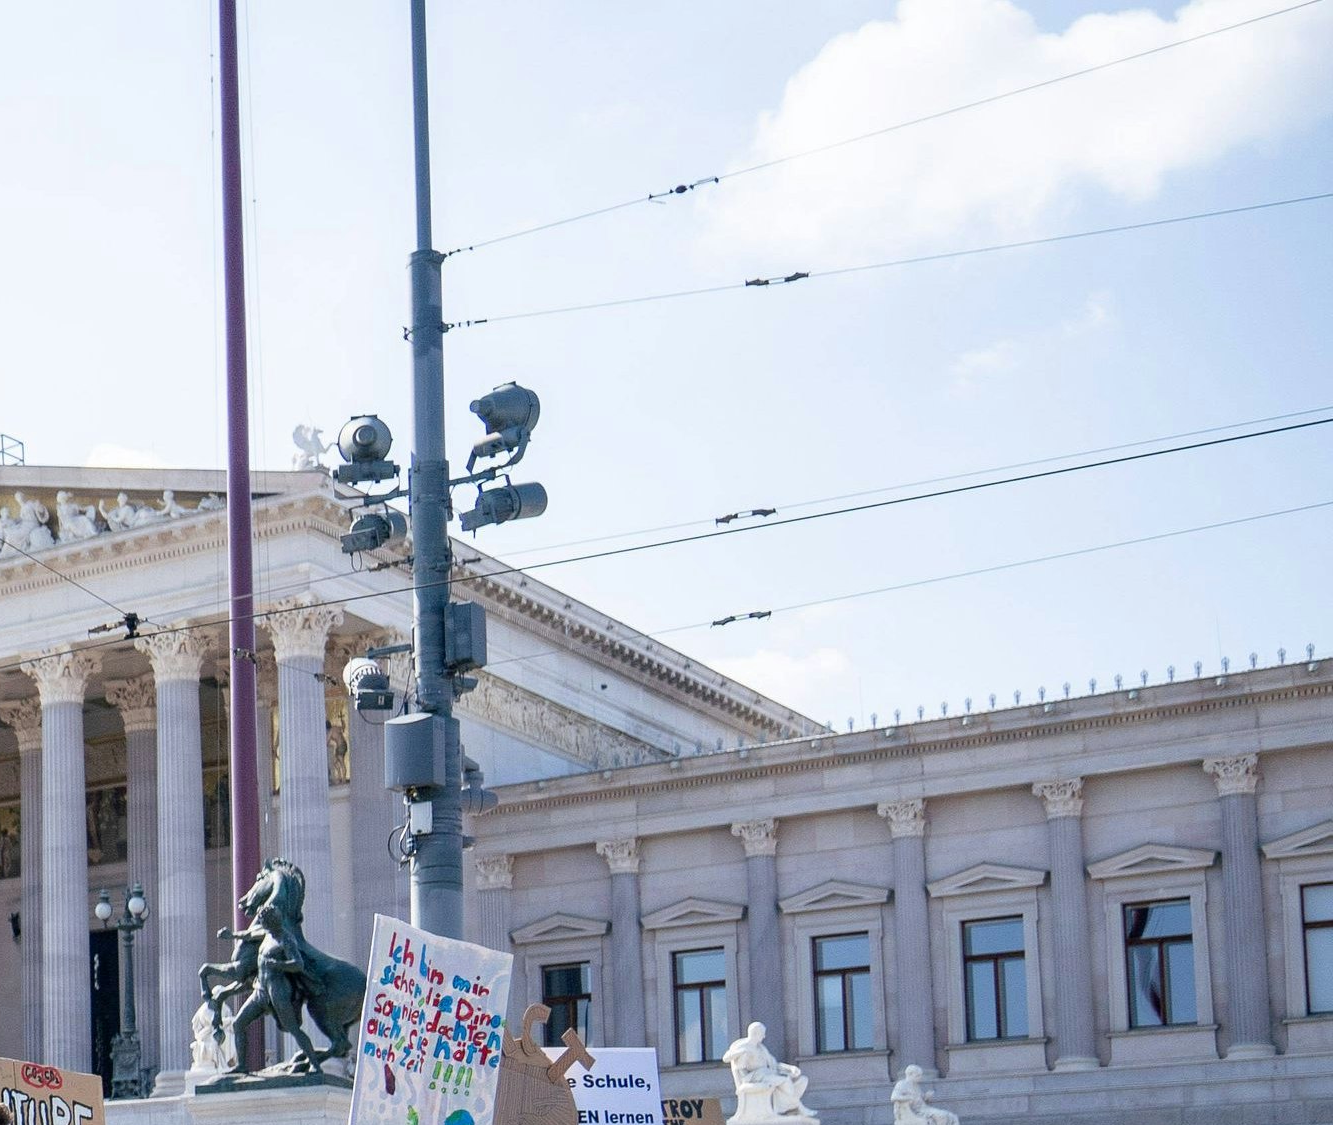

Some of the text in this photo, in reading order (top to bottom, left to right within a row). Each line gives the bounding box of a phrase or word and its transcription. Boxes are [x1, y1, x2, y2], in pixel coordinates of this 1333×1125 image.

[389, 932, 414, 967] Ich
[419, 944, 444, 985] bin
[426, 987, 453, 1013] die
[426, 1010, 501, 1050] dachten
[364, 1041, 395, 1063] noch
[433, 1035, 499, 1068] hätte
[583, 1074, 651, 1091] Schule,
[605, 1110, 654, 1124] lernen
[661, 1099, 704, 1119] TROY
